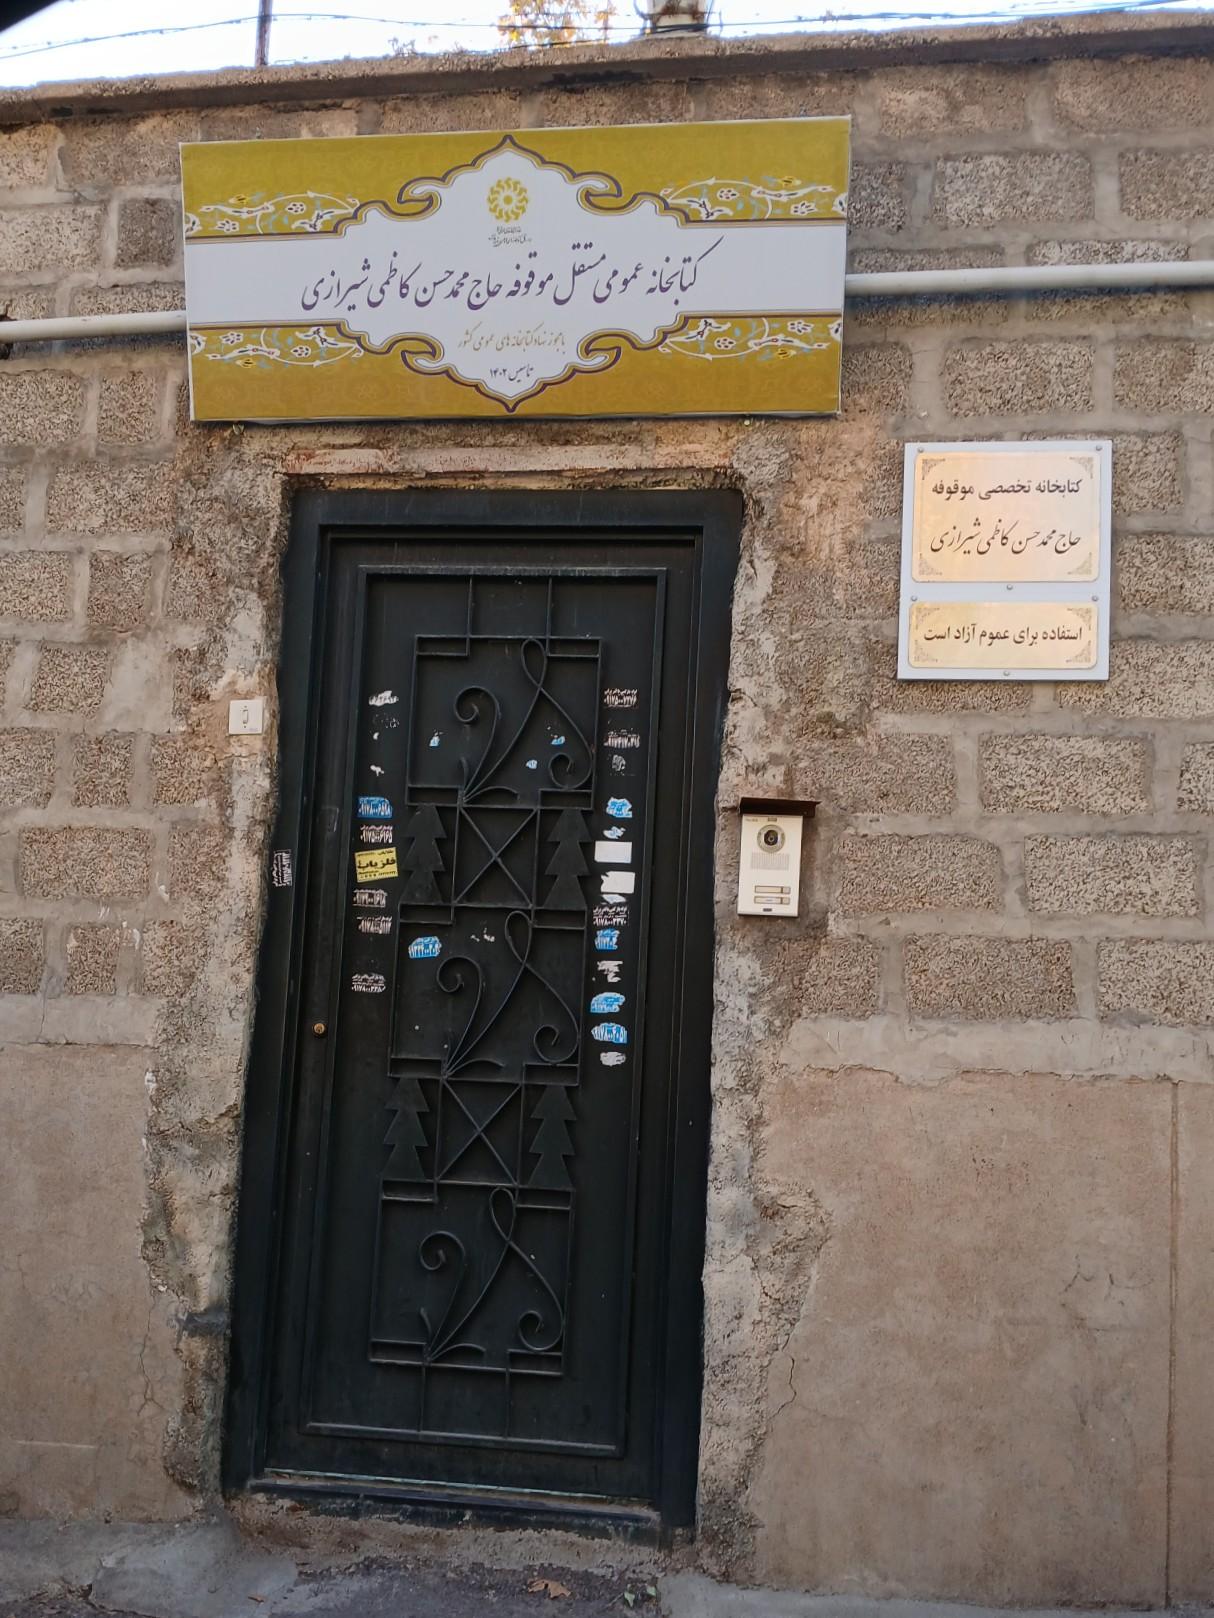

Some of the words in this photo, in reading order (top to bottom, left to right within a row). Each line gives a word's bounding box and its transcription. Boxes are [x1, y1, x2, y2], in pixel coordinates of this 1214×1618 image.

[301, 258, 370, 311] شیرازی
[367, 250, 422, 308] کاظمی
[505, 250, 554, 298] موقوفه
[553, 241, 606, 305] مستقل
[593, 261, 644, 304] عمومی
[646, 235, 724, 305] کتابخانه
[467, 271, 503, 310] حاج
[932, 480, 974, 501] موقوفه
[978, 480, 1032, 500] تخصصی
[1035, 479, 1082, 498] کتابخانه
[930, 517, 981, 554] شیرازی
[977, 518, 1019, 555] کاظمی
[1055, 531, 1081, 554] حاج
[924, 627, 950, 641] است
[953, 624, 977, 644] آزاد
[979, 630, 1010, 646] عموم
[1013, 626, 1038, 646] برای
[1042, 626, 1082, 642] استفاده
